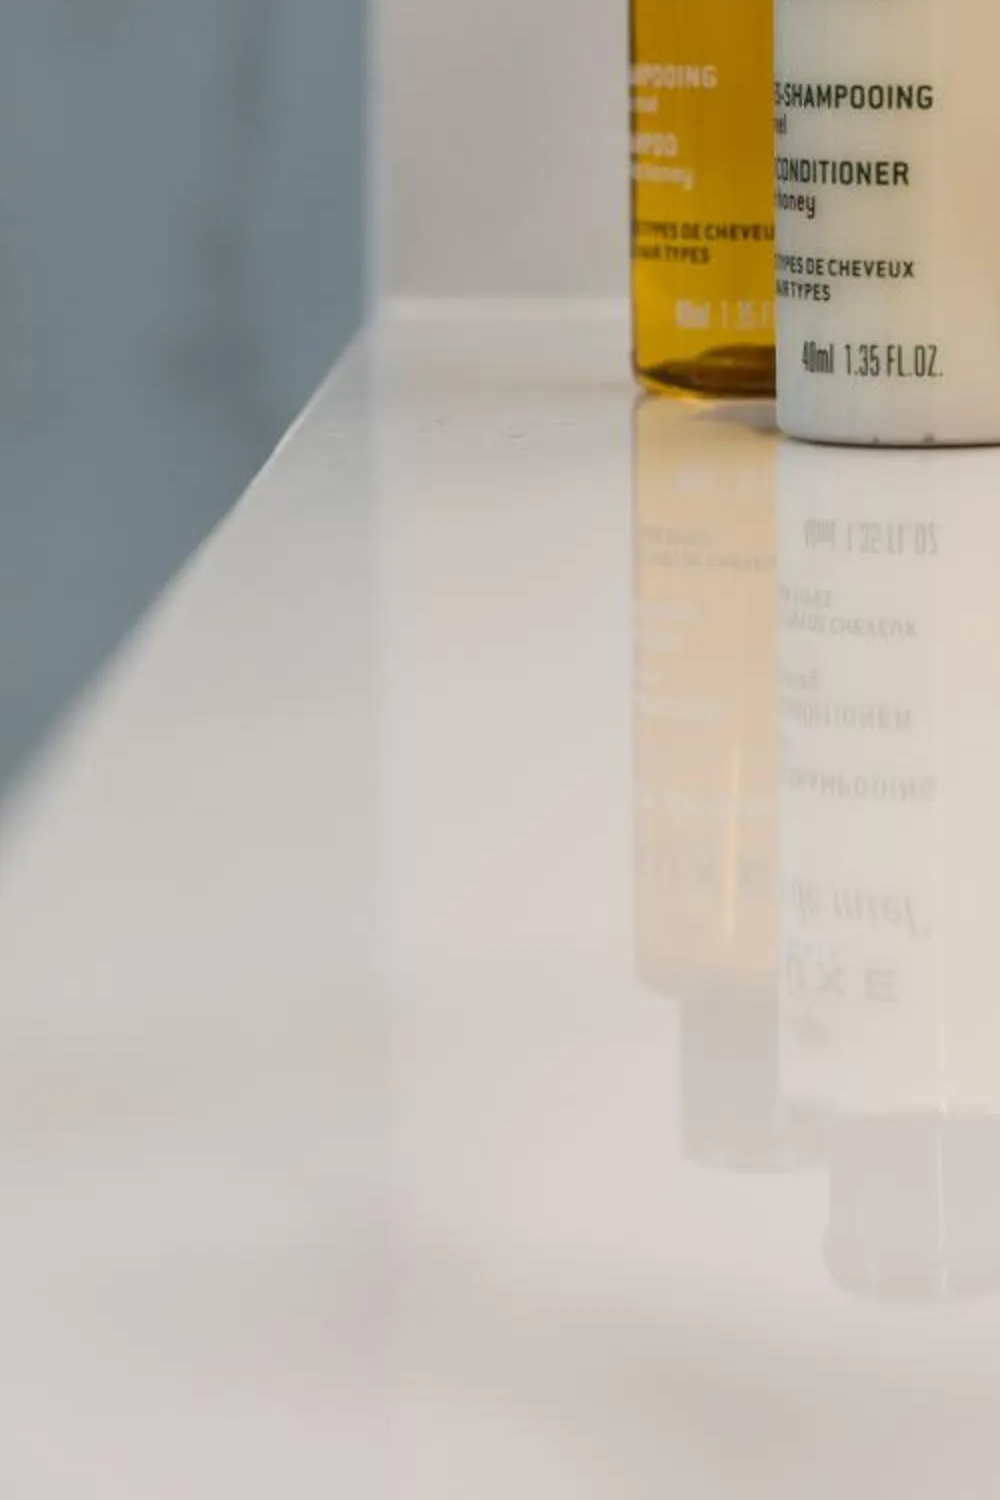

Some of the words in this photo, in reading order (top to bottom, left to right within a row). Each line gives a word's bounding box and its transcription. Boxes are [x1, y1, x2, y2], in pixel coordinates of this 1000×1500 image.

[703, 223, 775, 241] CHEVEU
[806, 257, 824, 276] DE
[828, 259, 915, 278] CHEVEUX
[791, 282, 831, 301] TYPES
[802, 340, 834, 373] 40ml
[844, 344, 881, 377] 1.35
